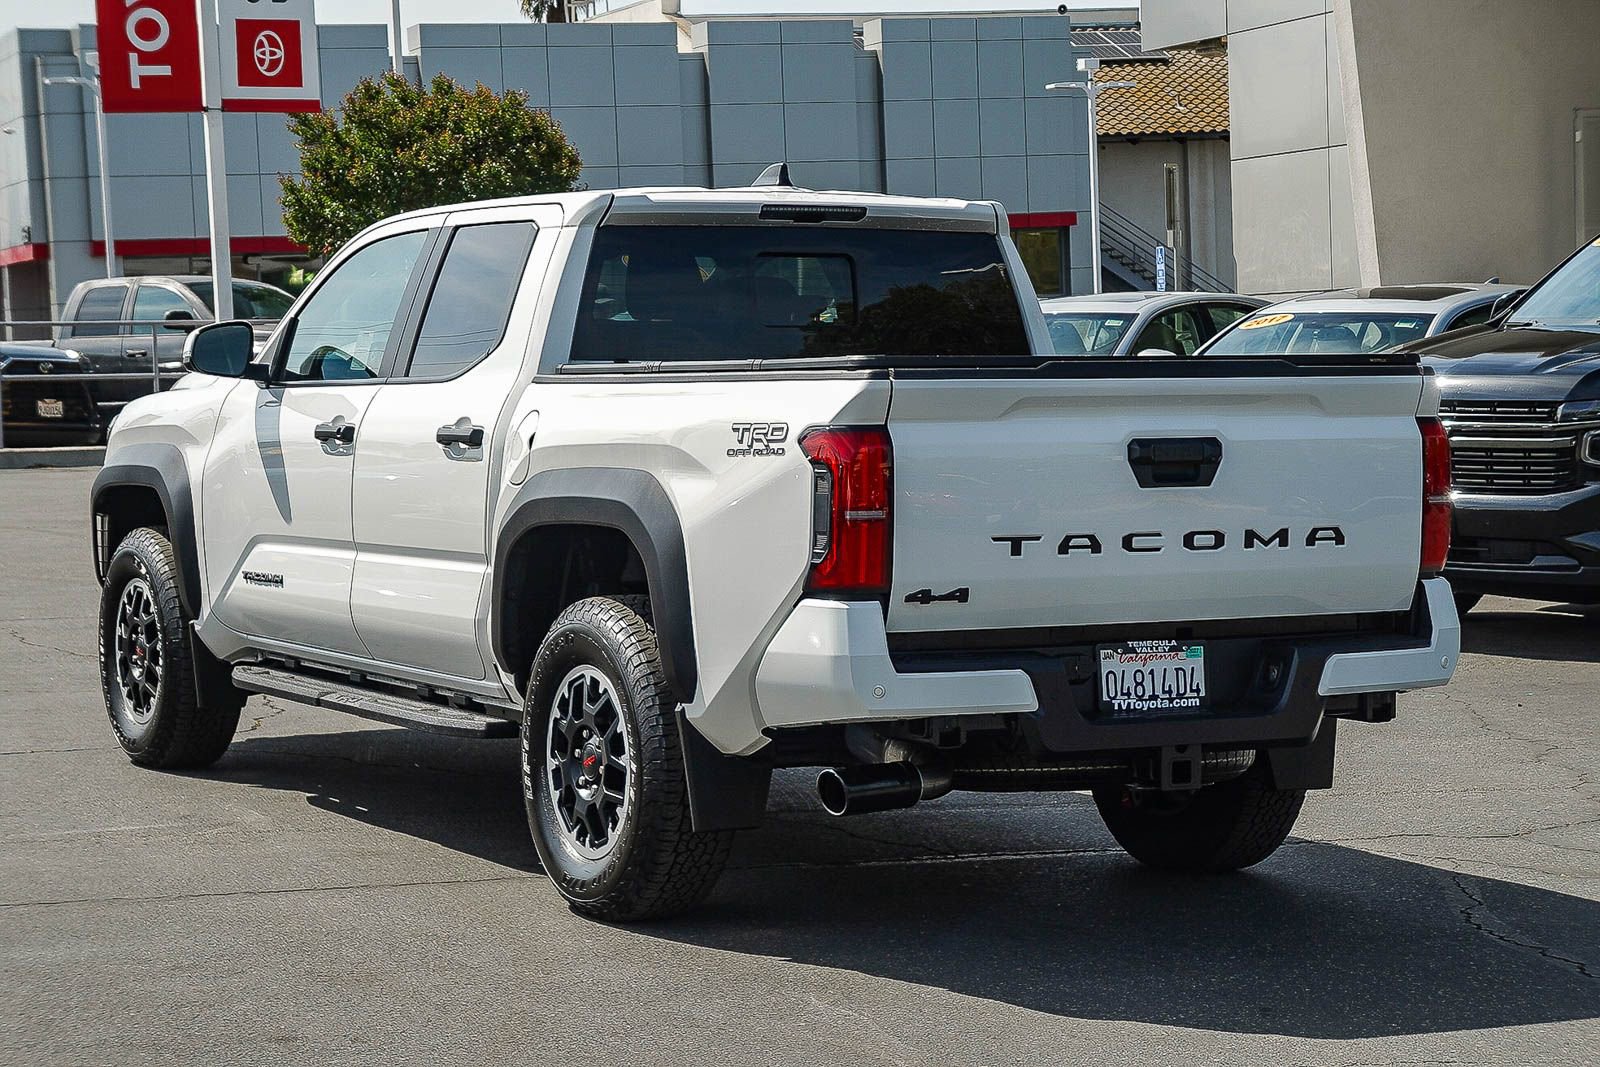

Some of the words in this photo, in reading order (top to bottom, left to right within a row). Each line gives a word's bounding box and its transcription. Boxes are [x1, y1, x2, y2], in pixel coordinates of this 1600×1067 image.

[125, 0, 172, 89] TO
[731, 423, 789, 448] TRD
[726, 448, 751, 457] OFF
[752, 447, 786, 457] ROAD
[992, 526, 1347, 557] TACOMA
[1127, 639, 1177, 648] TEMECULA
[1101, 651, 1115, 660] JAN
[1119, 651, 1187, 668] California
[1105, 665, 1202, 700] 04814D4
[1112, 698, 1200, 711] TVToyota.com
